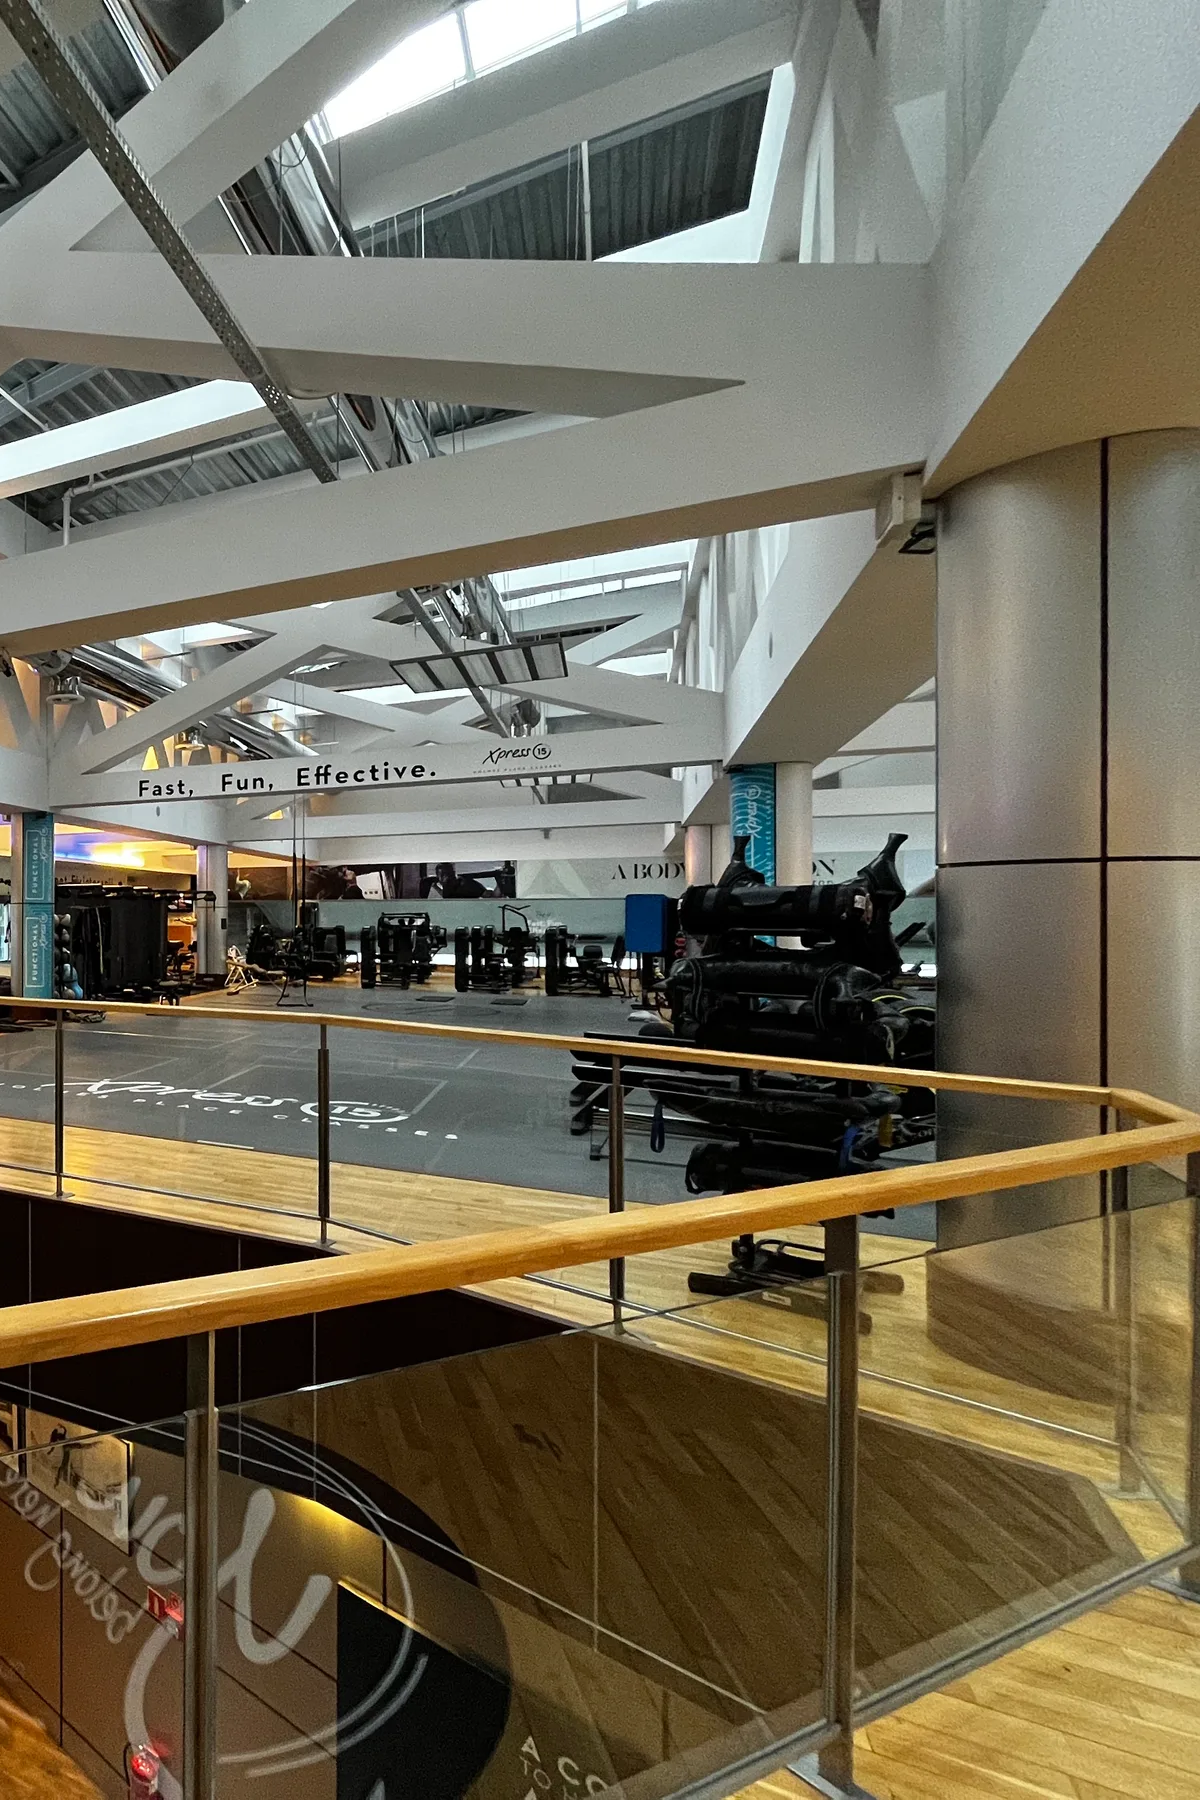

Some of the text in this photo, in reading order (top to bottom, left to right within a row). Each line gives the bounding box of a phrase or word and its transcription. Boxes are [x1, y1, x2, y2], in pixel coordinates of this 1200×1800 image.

[482, 747, 532, 765] Xpress
[138, 761, 437, 798] Fast, Fun, Effective.
[611, 864, 627, 879] A
[132, 1098, 243, 1115] PLACE
